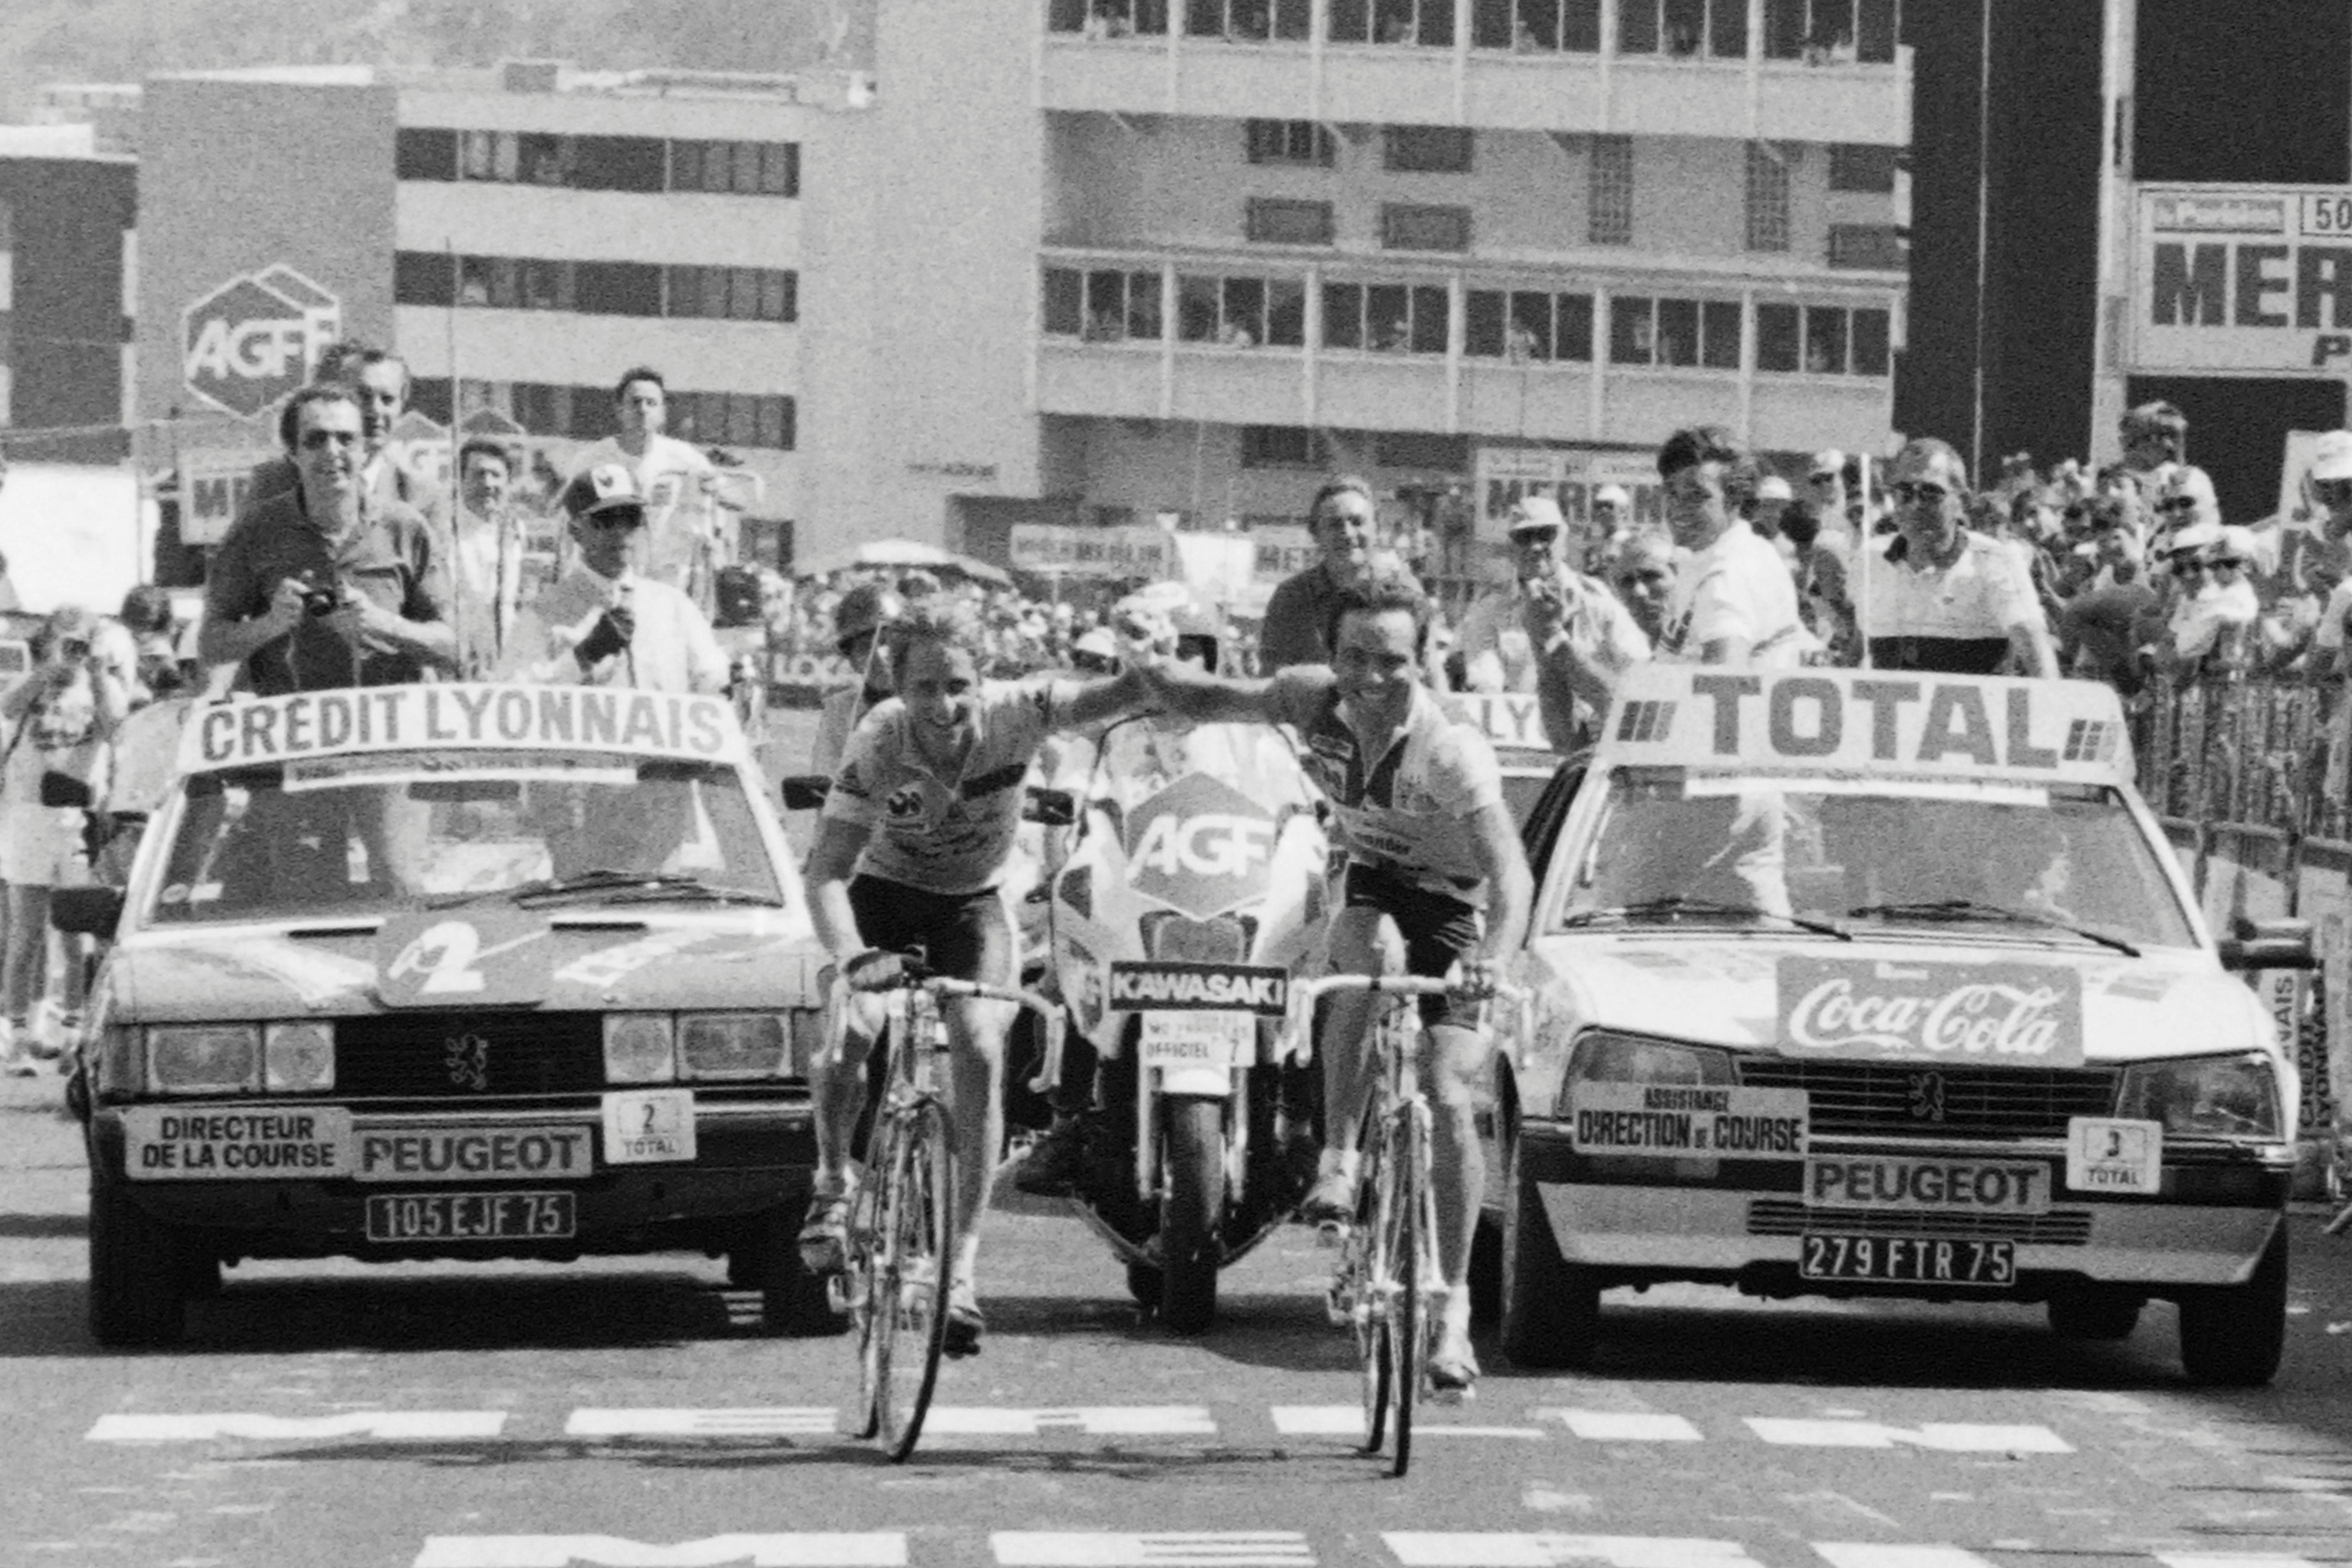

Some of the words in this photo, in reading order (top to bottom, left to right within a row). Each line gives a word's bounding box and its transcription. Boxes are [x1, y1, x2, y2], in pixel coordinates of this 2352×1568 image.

[201, 690, 406, 761] CREDIT
[425, 689, 725, 754] LYONNAIS
[1693, 675, 2058, 768] TOTAL
[1125, 814, 1276, 879] AGF
[1113, 972, 1283, 1005] KAWASAKI
[1789, 978, 2069, 1055] Coca-Cola
[162, 1116, 315, 1140] DIRECTEUR
[624, 1140, 675, 1157] TOTAL
[1578, 1110, 1691, 1148] DIRECTION
[1714, 1114, 1802, 1152] COURSE
[142, 1143, 176, 1168] DE
[183, 1143, 215, 1168] LA
[223, 1142, 335, 1169] COURSE
[362, 1133, 583, 1173] PEUGEOT
[1813, 1162, 2040, 1205] PEUGEOT
[2088, 1168, 2138, 1185] TOTAL
[384, 1198, 442, 1237] 105
[451, 1197, 509, 1235] EJF
[523, 1196, 560, 1233] 75
[1807, 1237, 1873, 1277] 279
[1887, 1240, 1953, 1281] FTR
[1968, 1243, 2009, 1281] 75
